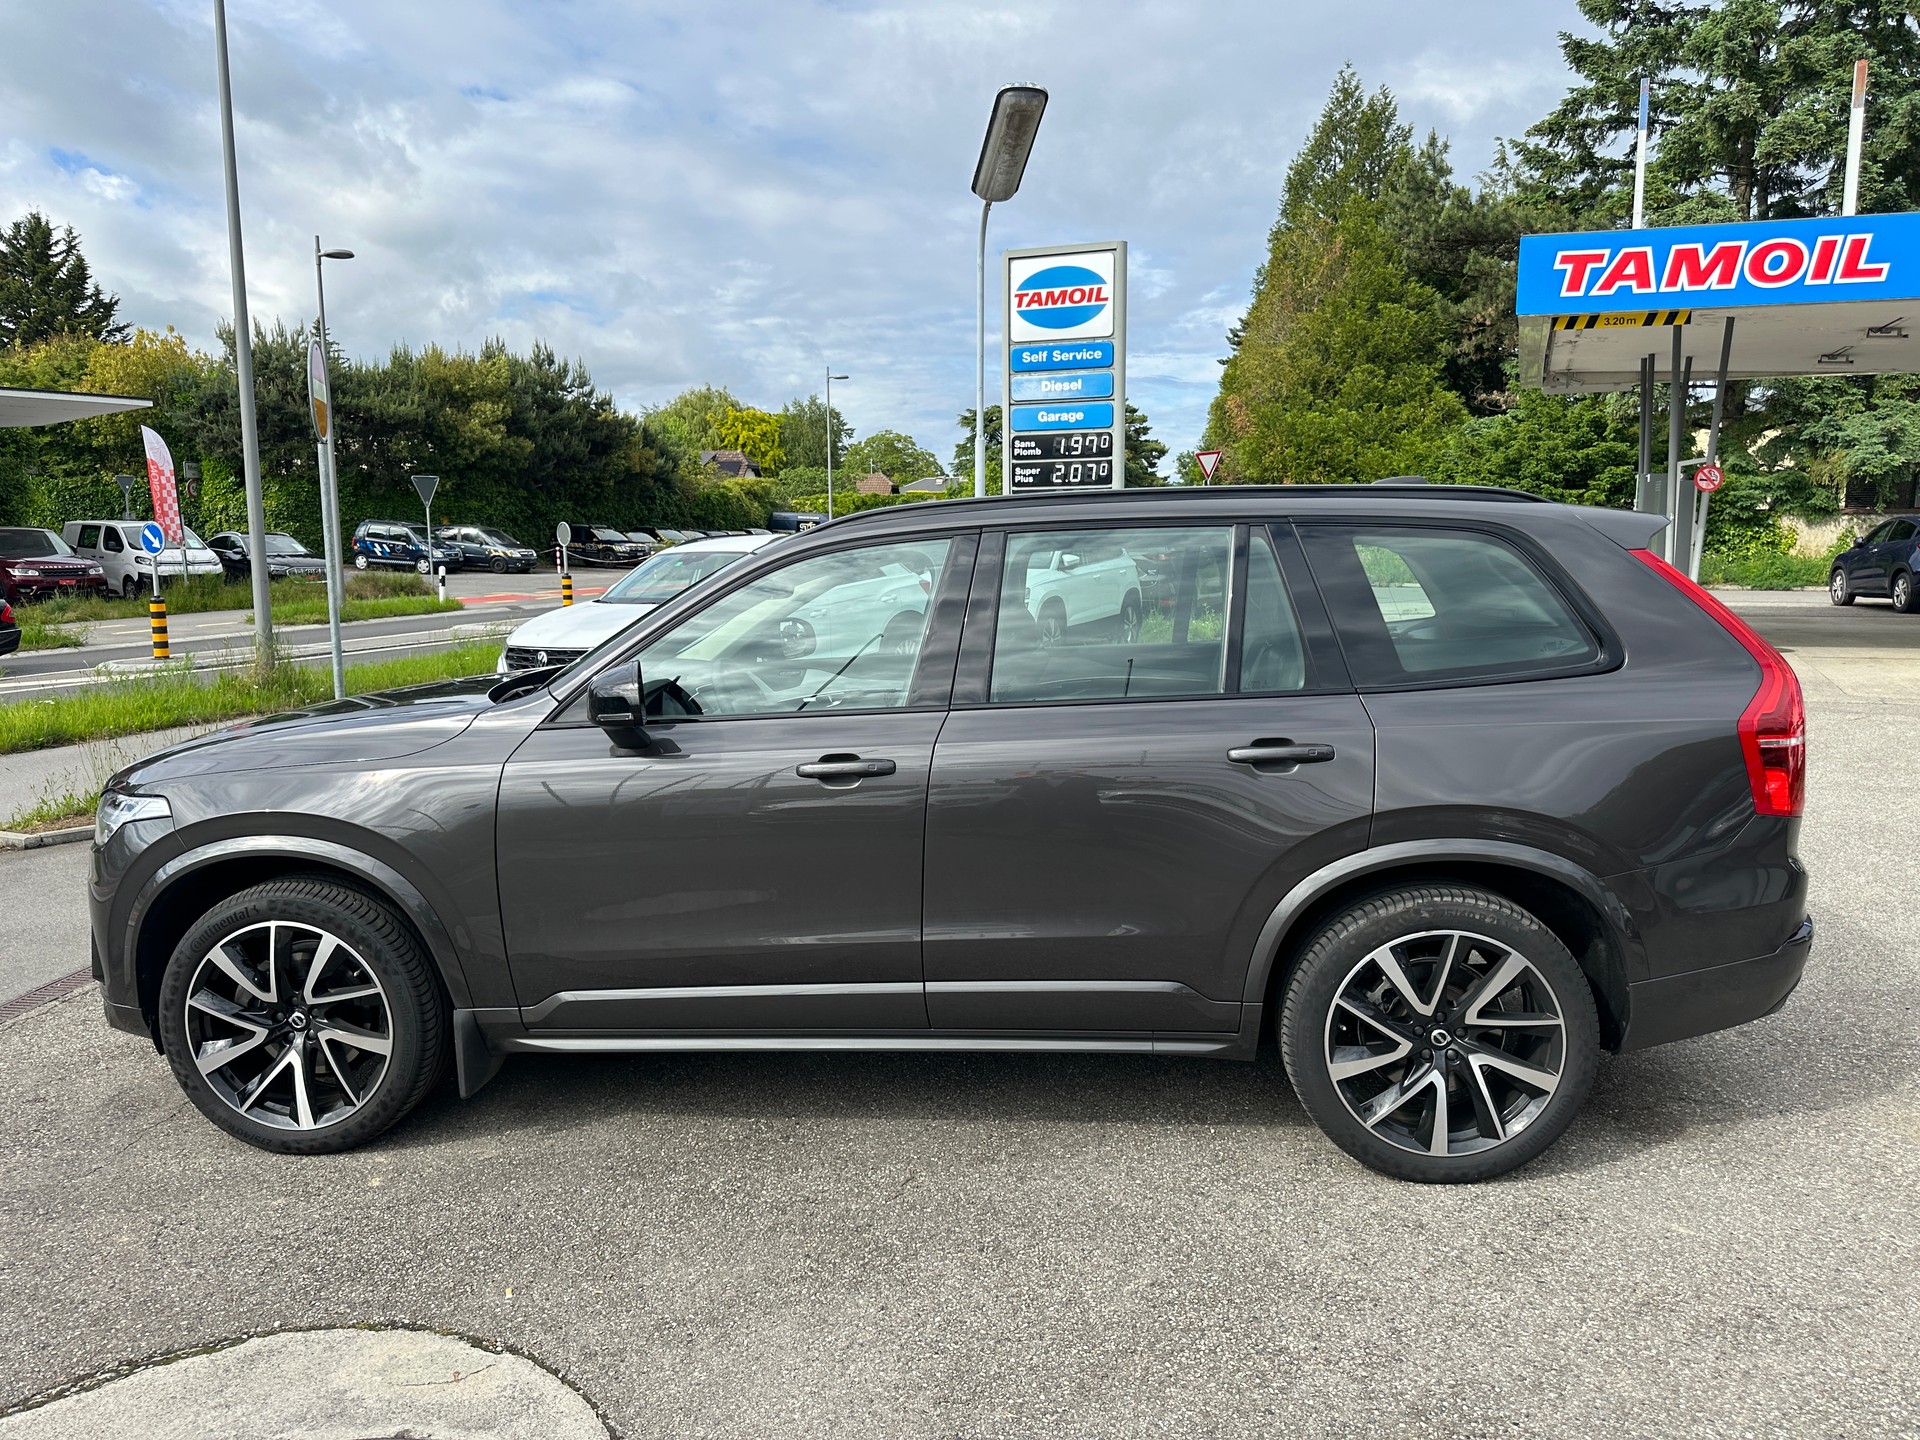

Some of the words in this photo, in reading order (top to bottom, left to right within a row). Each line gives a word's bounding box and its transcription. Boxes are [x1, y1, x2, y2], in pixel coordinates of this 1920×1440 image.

[1554, 233, 1890, 297] TAMOIL
[1014, 286, 1108, 308] TAMOIL
[1604, 316, 1626, 327] 3.20
[1626, 318, 1637, 326] m
[1022, 351, 1047, 363] Self
[1052, 348, 1102, 362] Service
[1041, 379, 1082, 392] Diesel
[1038, 411, 1084, 423] Garage
[1014, 440, 1035, 448] Sans
[1014, 448, 1042, 456] Plomb
[1015, 467, 1040, 476] Super
[1052, 463, 1108, 483] 2.070
[1015, 475, 1034, 483] Plus
[190, 908, 250, 953] Continental
